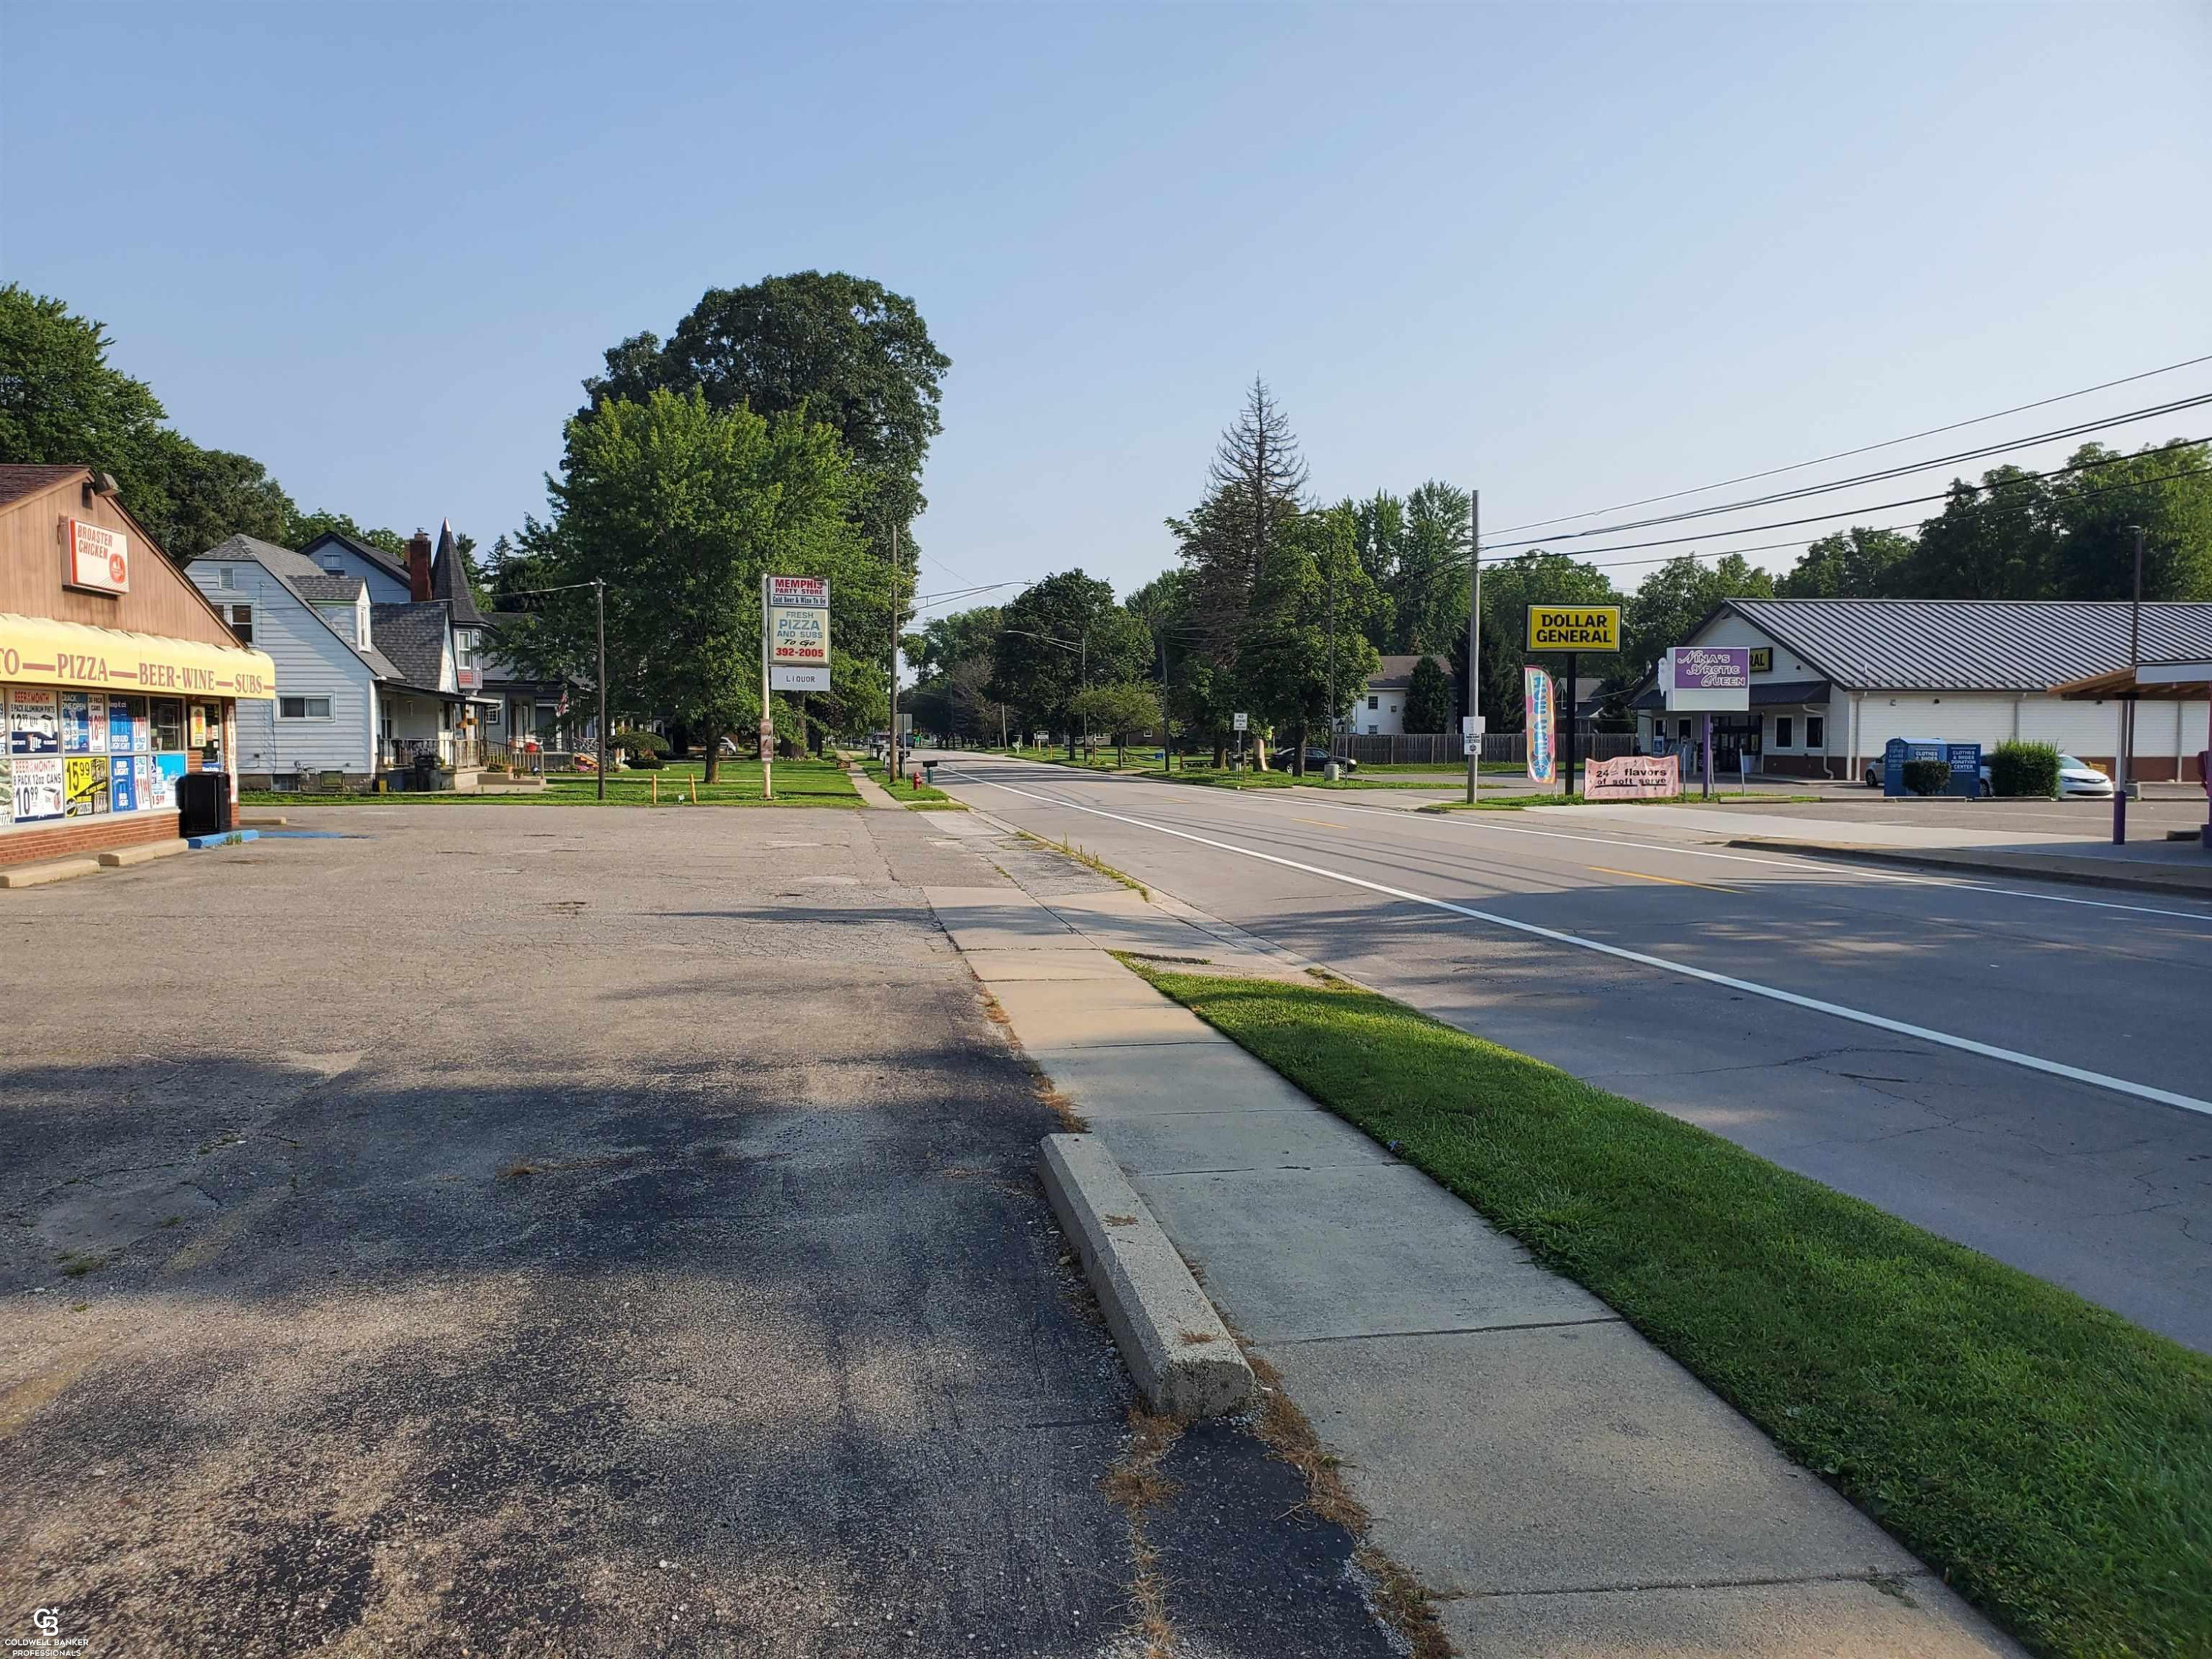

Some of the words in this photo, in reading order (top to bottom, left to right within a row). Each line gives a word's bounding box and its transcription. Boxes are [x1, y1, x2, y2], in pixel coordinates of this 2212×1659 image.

[77, 525, 113, 547] BROASTER
[78, 540, 108, 560] CHICKEN
[775, 579, 823, 588] MEMPHIS
[779, 619, 820, 630] PIZZA
[1541, 614, 1607, 627] DOLLAR
[1537, 630, 1612, 643] GENERAL
[776, 647, 824, 657] 392-2005
[57, 653, 108, 681] PIZZA
[234, 673, 262, 694] SUBS
[15, 691, 27, 703] BEER
[31, 692, 49, 703] MONTH
[15, 760, 29, 773] BEER
[34, 760, 55, 773] MONTH
[1624, 768, 1667, 776] flavors
[18, 775, 31, 785] PACK
[46, 773, 61, 784] CANS
